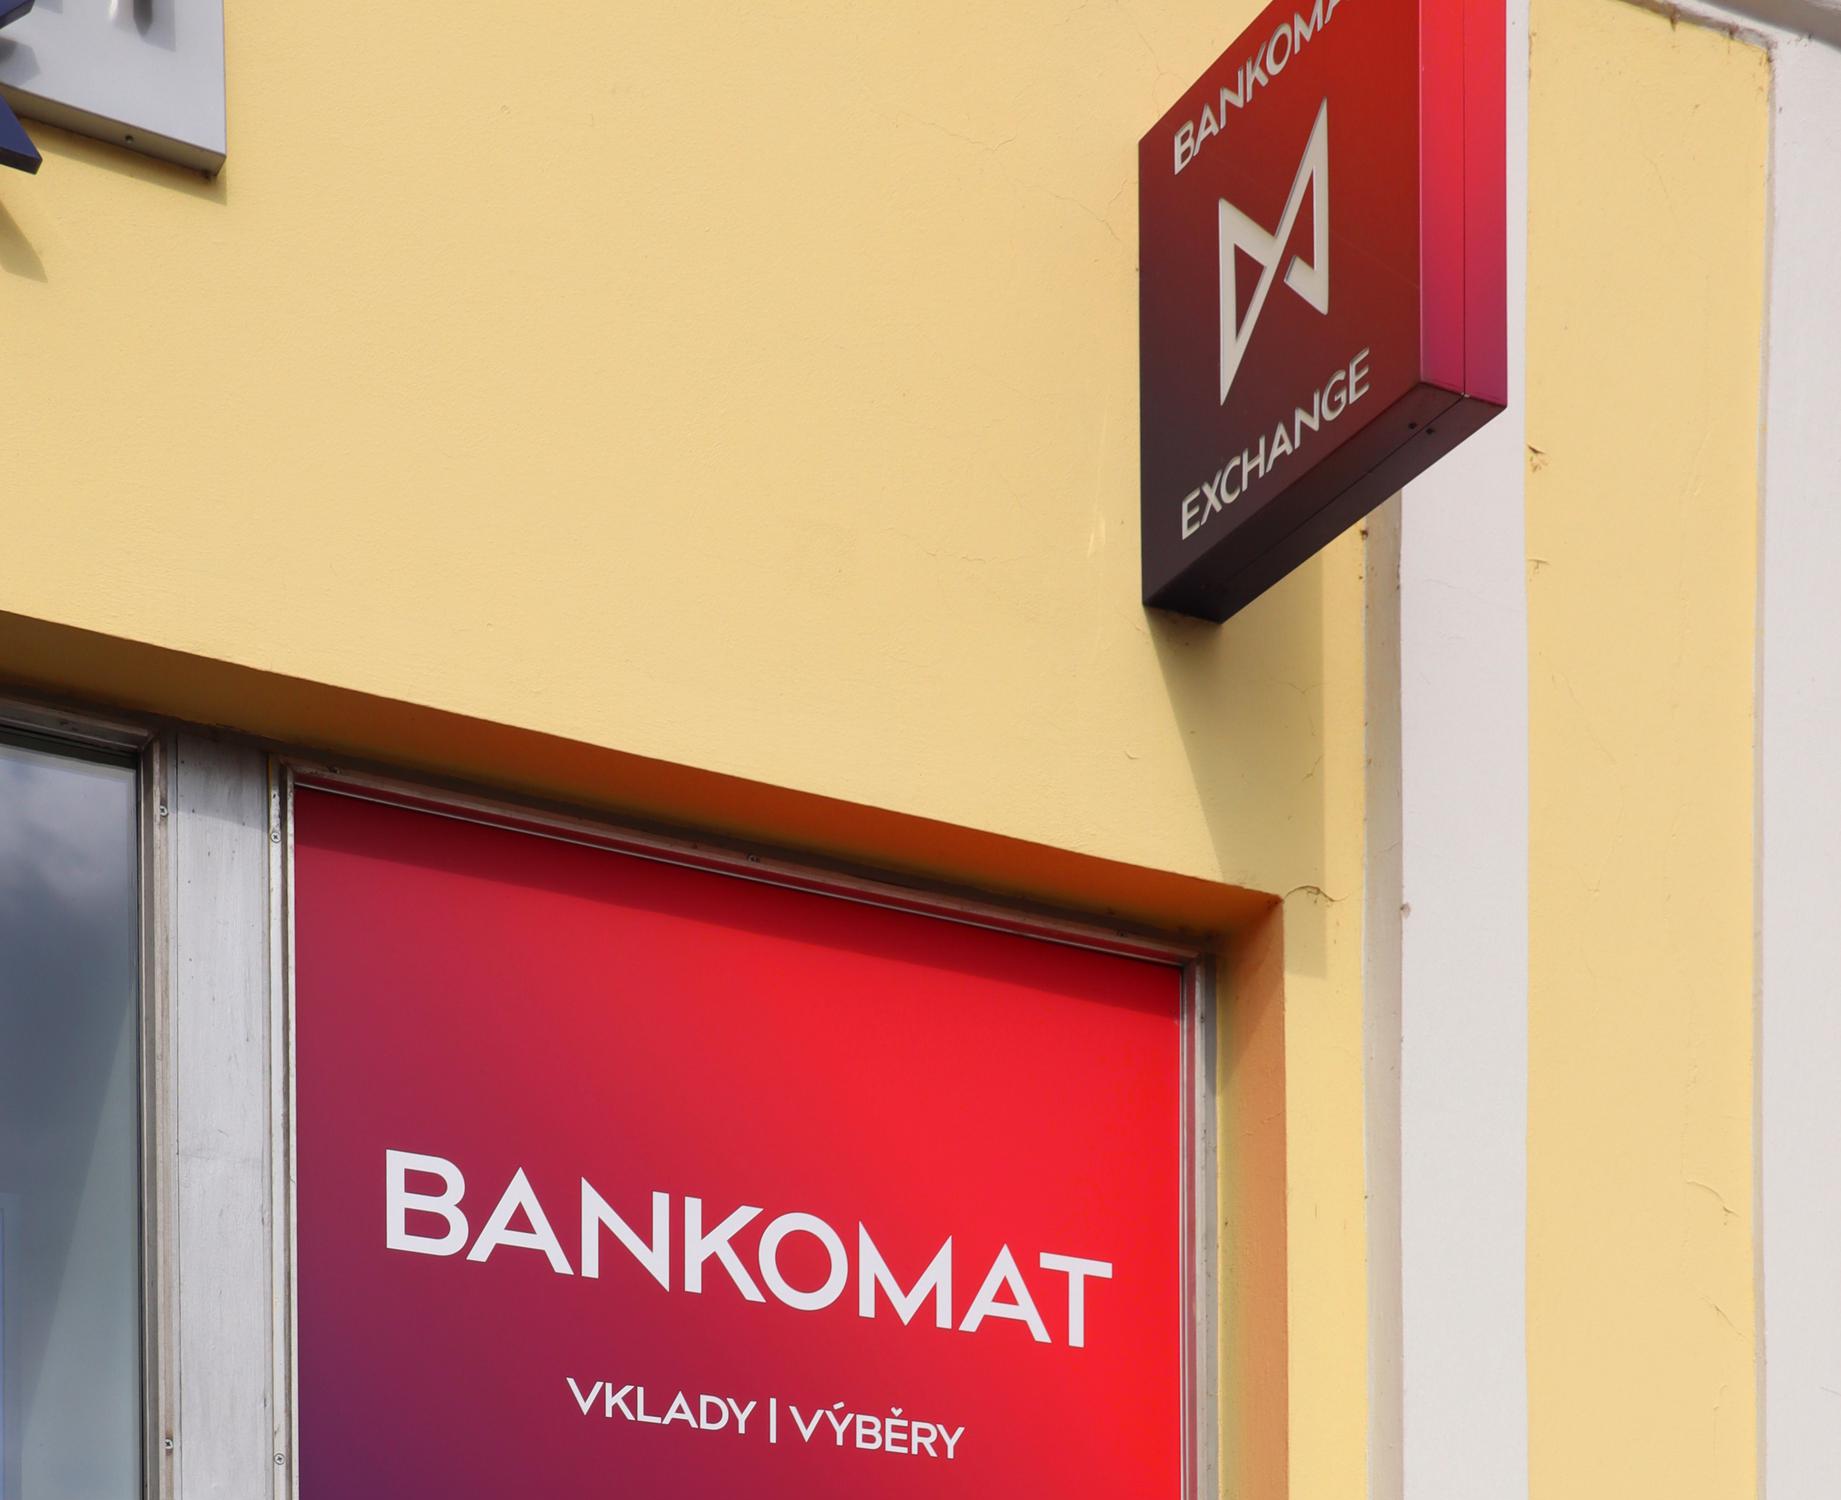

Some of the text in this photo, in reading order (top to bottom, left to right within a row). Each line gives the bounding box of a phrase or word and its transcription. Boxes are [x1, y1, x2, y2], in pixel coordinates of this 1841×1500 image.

[1180, 347, 1371, 541] EXCHANGE
[386, 1149, 1113, 1348] BANKOMAT
[566, 1377, 757, 1435] VKLADY
[789, 1401, 965, 1460] VÝBĚRY
